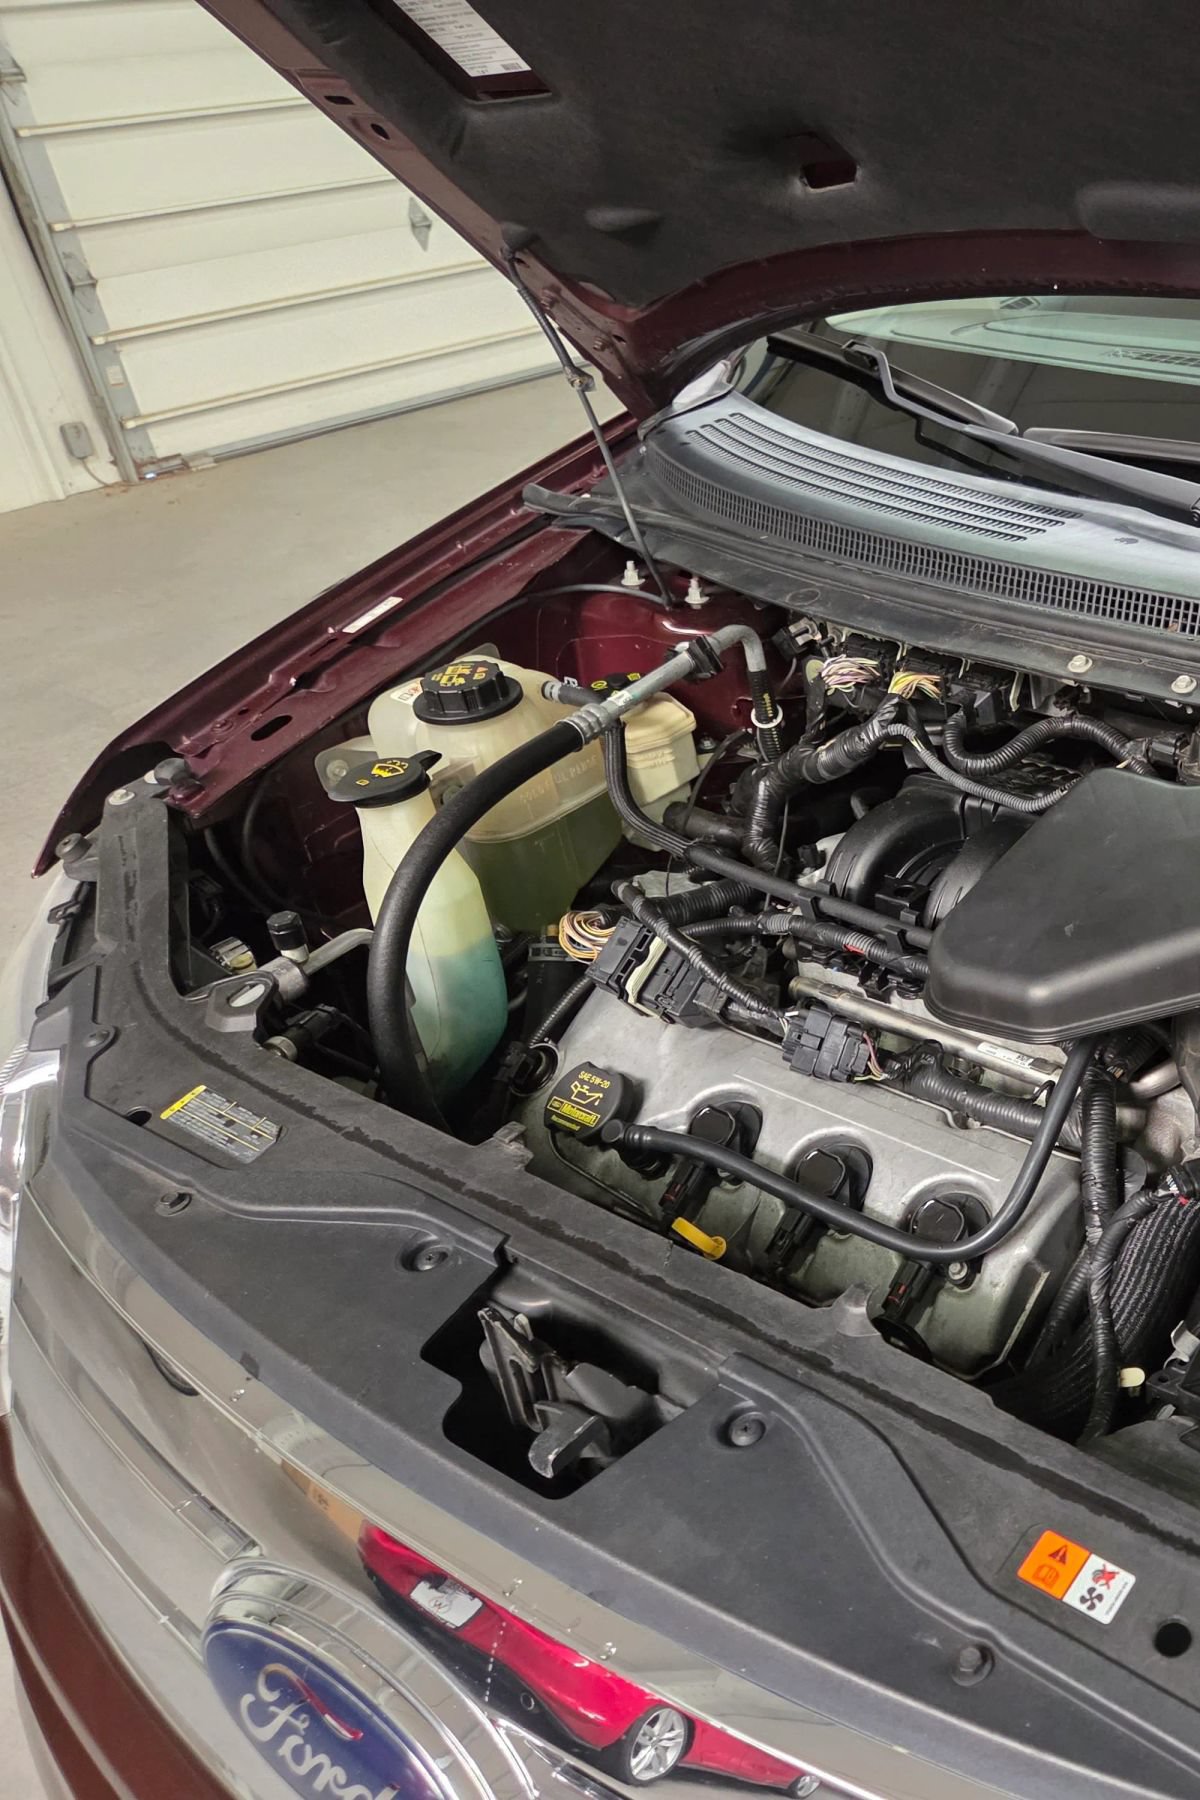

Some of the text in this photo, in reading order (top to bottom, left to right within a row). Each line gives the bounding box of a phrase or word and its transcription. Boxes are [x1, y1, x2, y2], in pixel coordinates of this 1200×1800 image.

[579, 1071, 610, 1088] SAE 5W-20
[561, 1103, 596, 1125] Motorcraft
